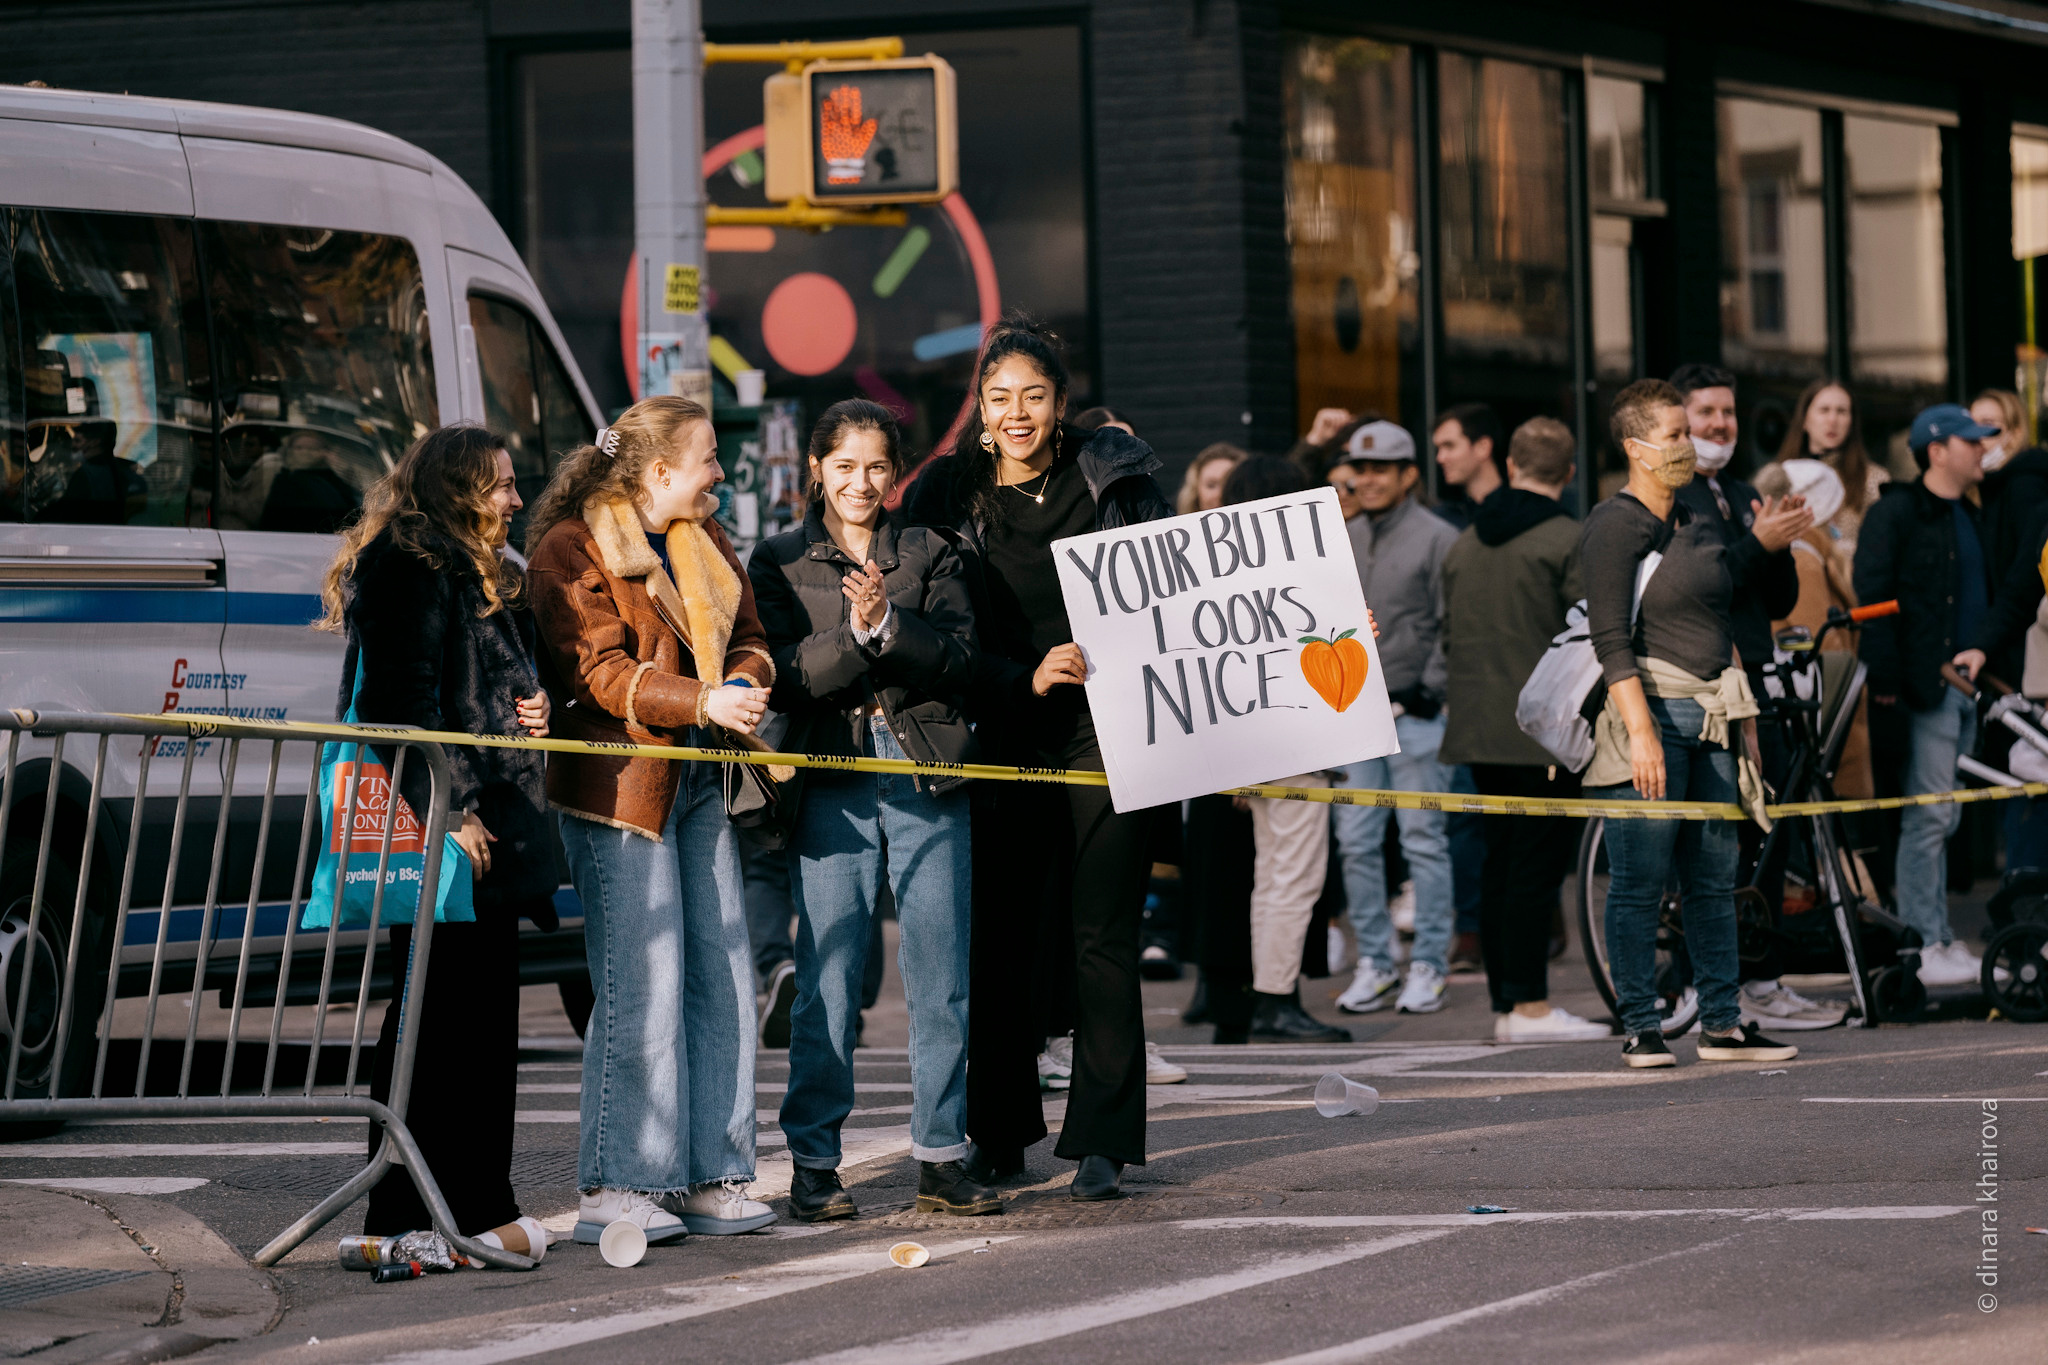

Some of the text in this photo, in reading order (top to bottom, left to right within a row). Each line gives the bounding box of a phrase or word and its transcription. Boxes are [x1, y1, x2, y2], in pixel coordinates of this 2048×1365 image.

[1065, 501, 1326, 616] YOUR BUTT
[1152, 586, 1317, 654] LOOKS
[139, 735, 213, 758] ESPCT
[341, 775, 393, 810] KIN
[368, 793, 411, 814] Coleg
[337, 867, 396, 884] sycholgy
